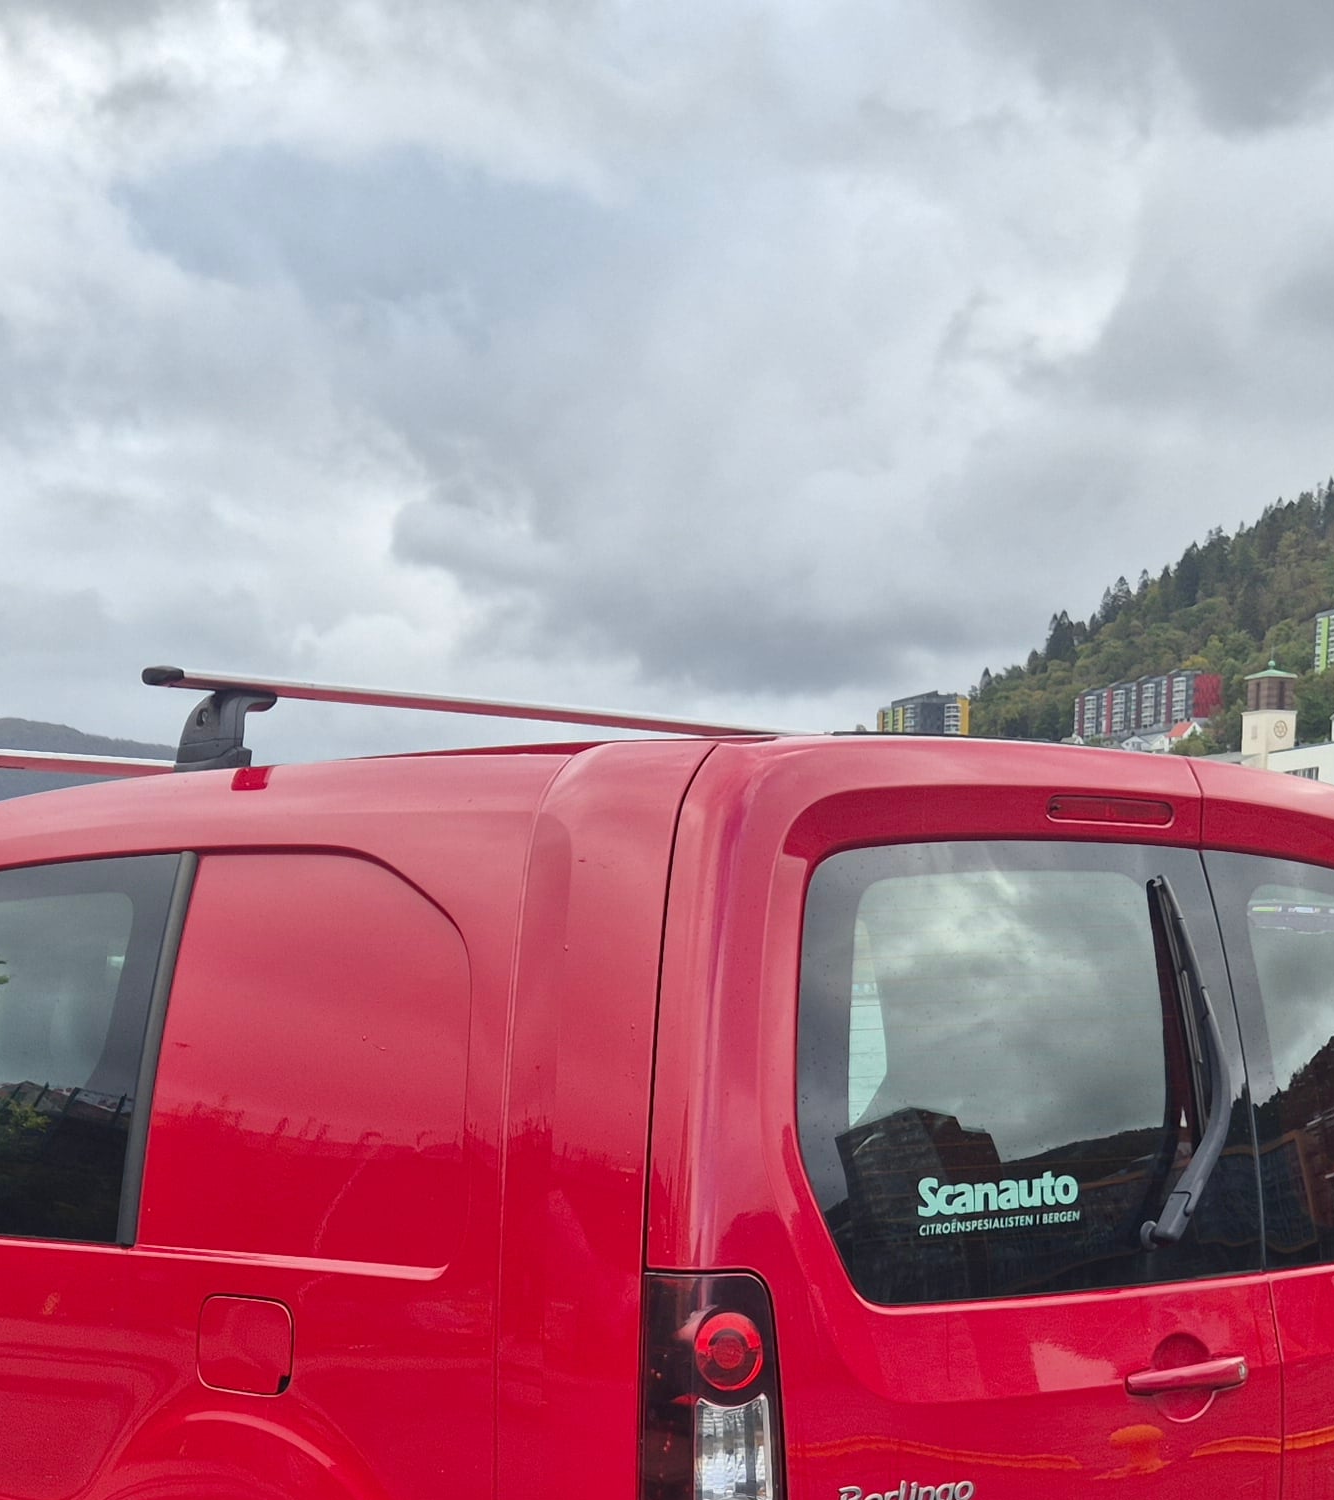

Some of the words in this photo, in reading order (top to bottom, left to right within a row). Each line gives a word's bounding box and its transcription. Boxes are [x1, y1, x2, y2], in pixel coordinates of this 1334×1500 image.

[917, 1171, 1079, 1217] Scanauto
[919, 1214, 1033, 1236] CITROËNSPESIALISTEN
[1042, 1210, 1080, 1225] BERGEN
